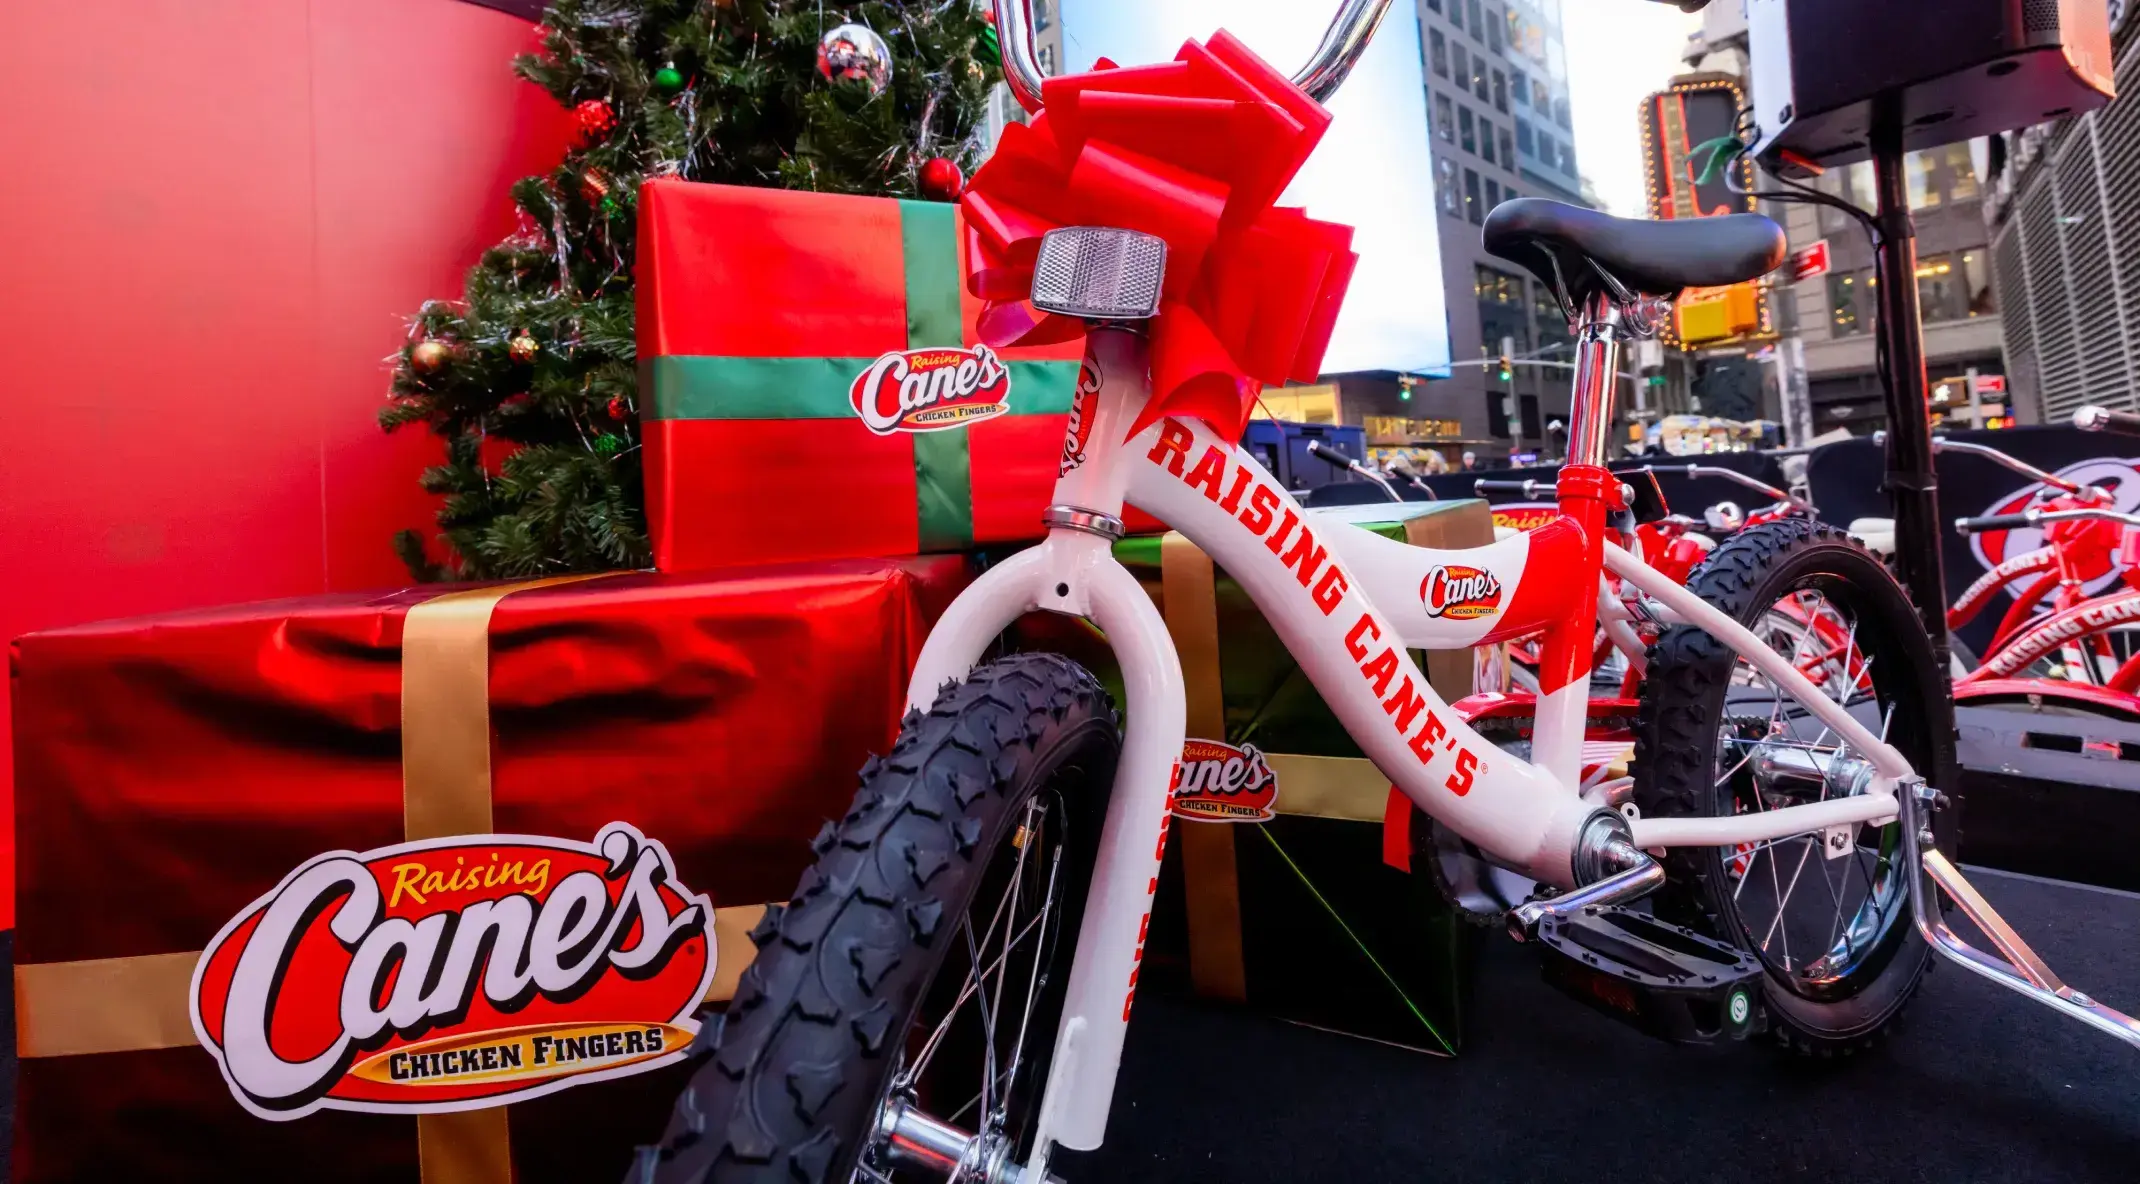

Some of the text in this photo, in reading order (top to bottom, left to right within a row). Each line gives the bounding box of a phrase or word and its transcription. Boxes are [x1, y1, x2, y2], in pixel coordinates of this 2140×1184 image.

[910, 353, 961, 371] Raising
[861, 346, 1007, 432] Cane's
[915, 404, 997, 423] CHICKEN FINGERS
[1147, 416, 1348, 617] RAISING
[1345, 613, 1478, 797] CANE'S
[1424, 565, 1501, 618] Cane's
[1990, 616, 2084, 676] RAISING
[1175, 745, 1275, 796] ane's
[1180, 799, 1261, 817] CHICKEN FINGERS
[389, 853, 552, 908] Raising
[222, 830, 706, 1112] Cane's
[389, 1028, 664, 1081] CHICKEN FINGERS
